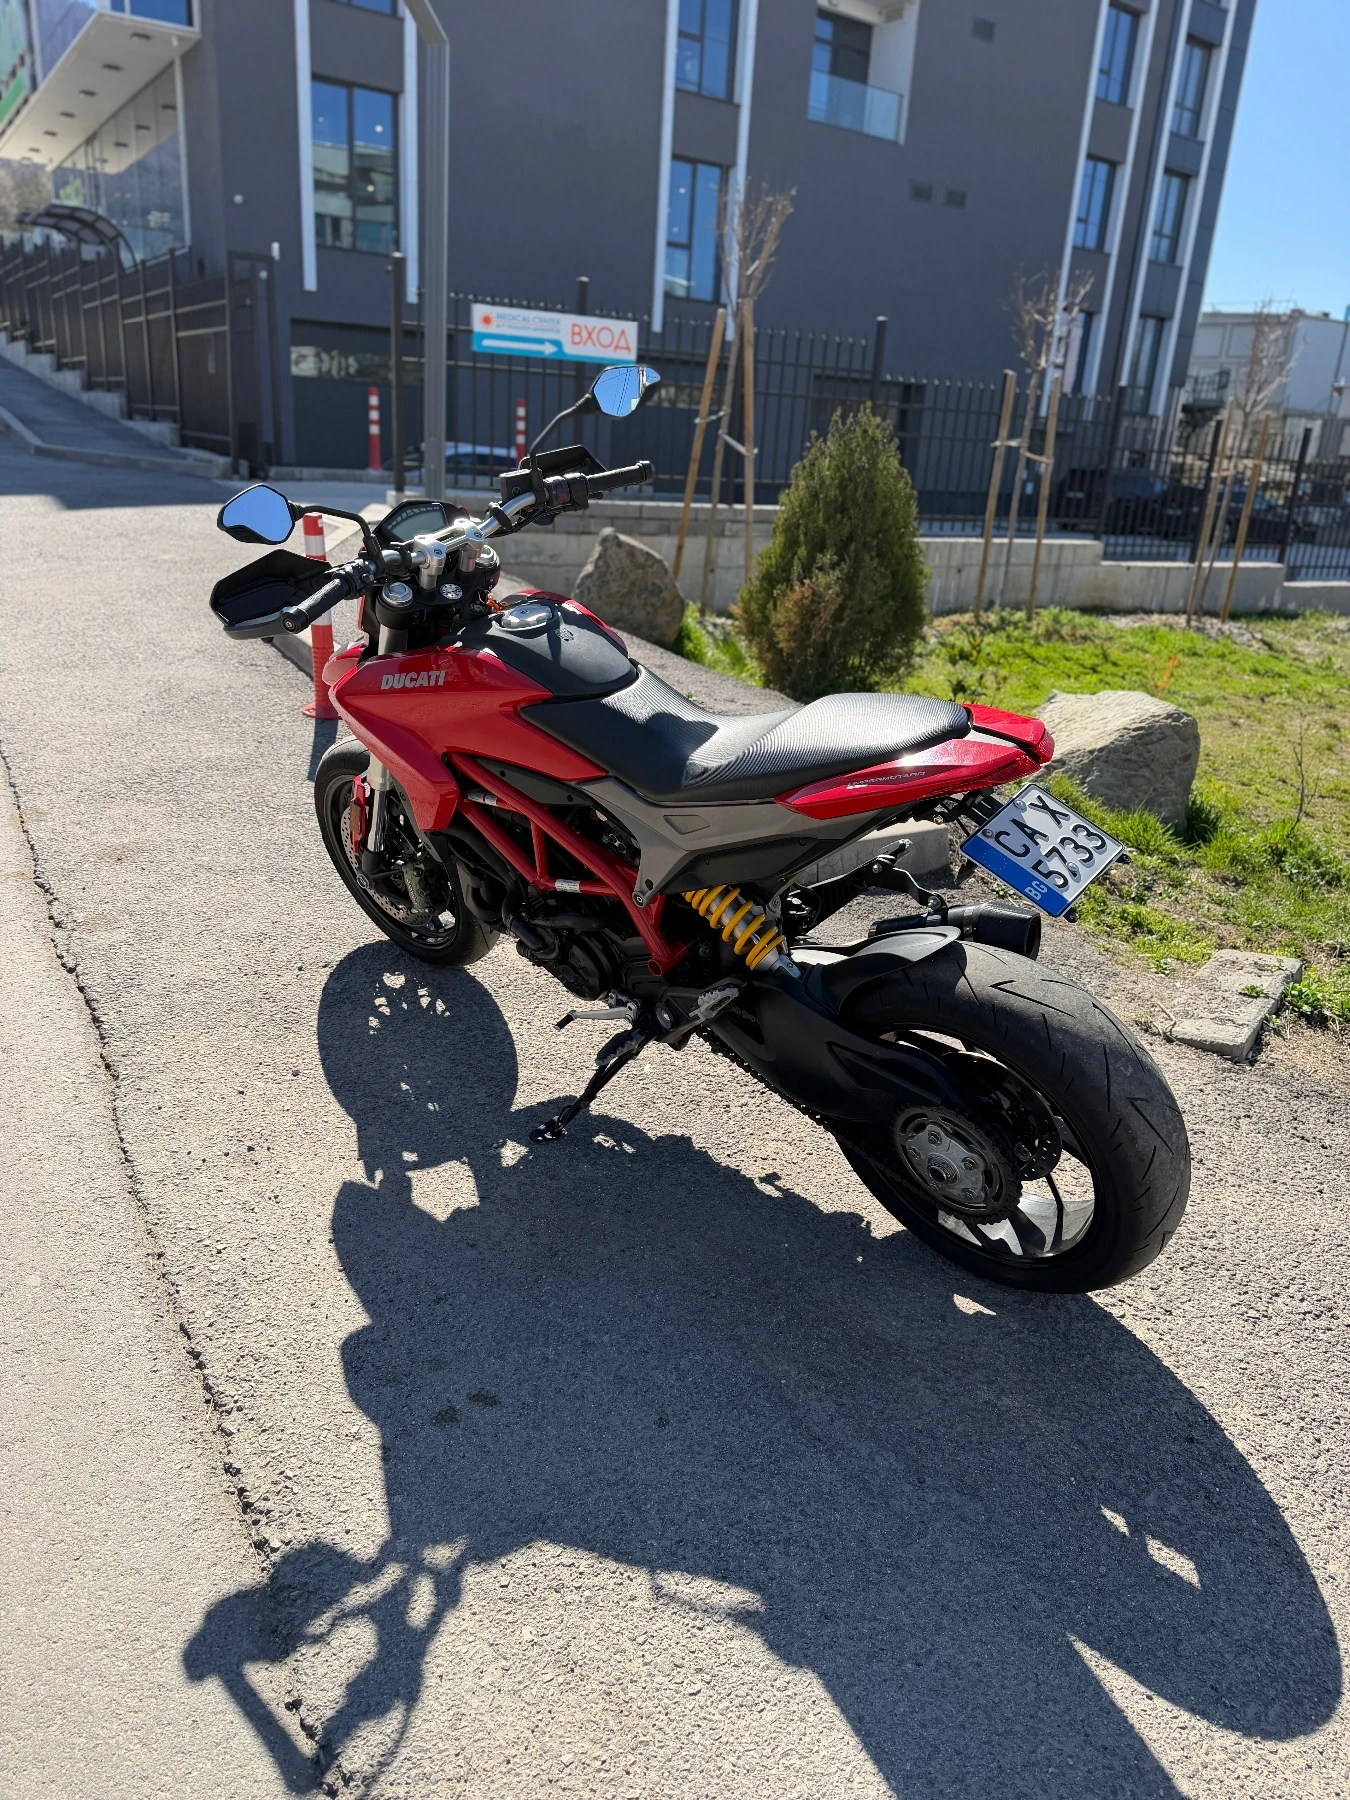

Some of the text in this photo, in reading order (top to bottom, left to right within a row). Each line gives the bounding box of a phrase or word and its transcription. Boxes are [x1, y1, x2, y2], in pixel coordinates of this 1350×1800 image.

[571, 323, 631, 354] ВХОД
[381, 670, 446, 690] DUCATI
[994, 794, 1071, 858] CA X
[1031, 823, 1107, 889] 5733
[1024, 880, 1049, 901] BG
